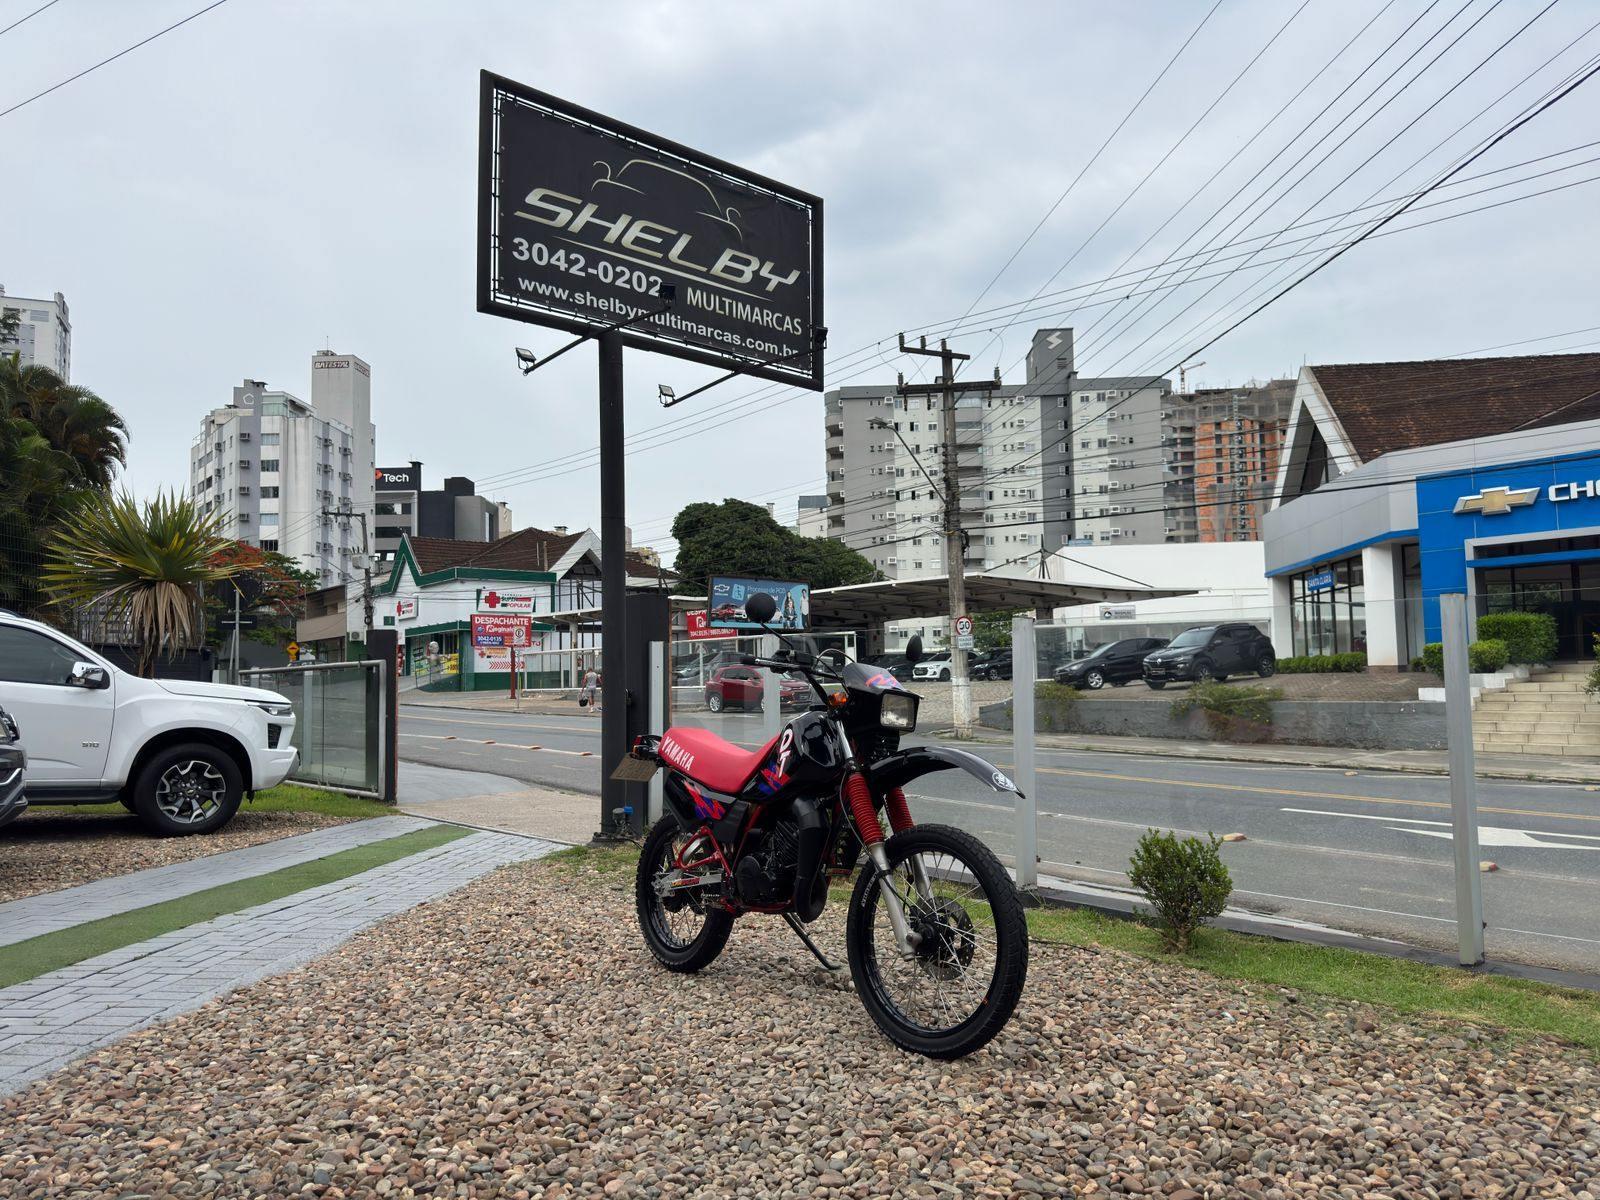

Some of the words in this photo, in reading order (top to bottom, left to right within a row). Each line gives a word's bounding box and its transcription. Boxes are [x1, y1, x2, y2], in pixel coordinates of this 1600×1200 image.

[514, 188, 800, 292] SHELBY
[511, 236, 663, 298] 3042-0202
[686, 286, 803, 336] MULTIMARCAS
[383, 473, 409, 483] Tech
[1548, 480, 1600, 501] CH
[475, 616, 530, 626] DESPACHANTE
[661, 736, 695, 771] YAMAHA
[778, 728, 793, 779] DT
